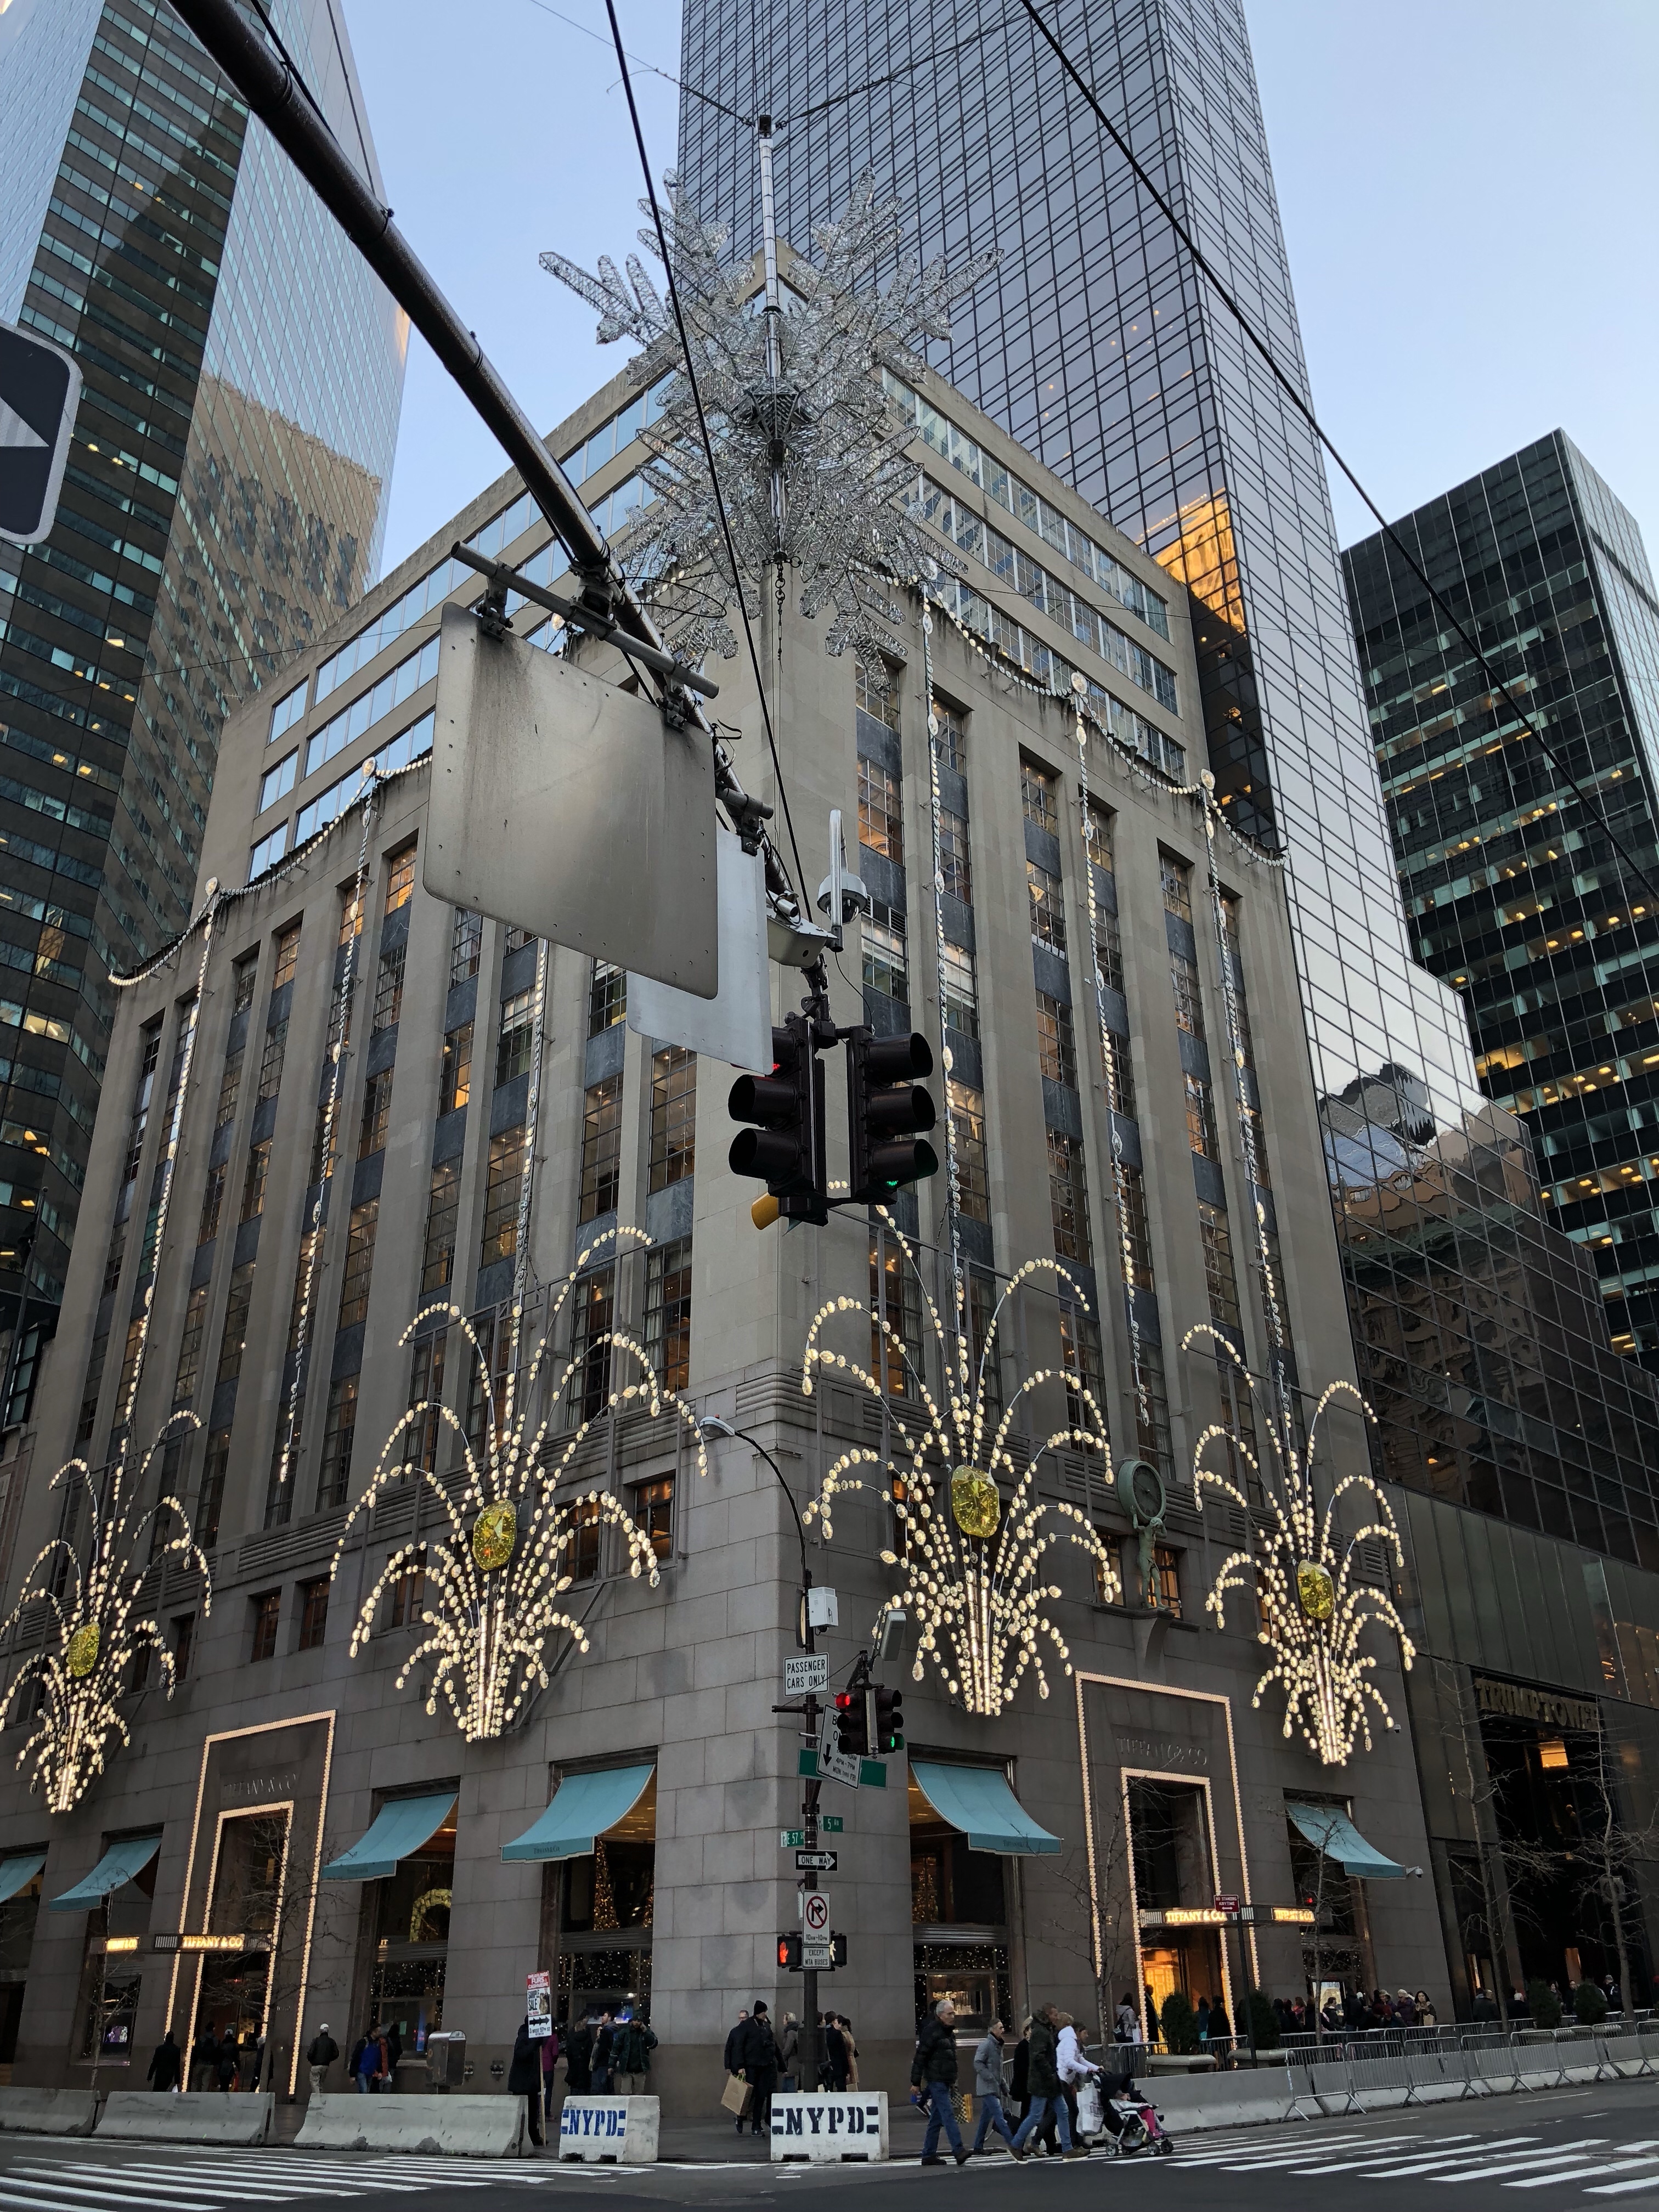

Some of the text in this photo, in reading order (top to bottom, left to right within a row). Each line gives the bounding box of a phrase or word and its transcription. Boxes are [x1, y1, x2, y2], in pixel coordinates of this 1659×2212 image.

[787, 1659, 825, 1674] PASSENGER
[787, 1674, 825, 1689] CARS ONLY
[827, 1819, 831, 1830] 5
[787, 1833, 790, 1844] E
[792, 1832, 798, 1844] 57
[819, 1857, 831, 1865] WAY
[1165, 1910, 1202, 1922] TIFFANY
[1203, 1910, 1210, 1921] &
[183, 1936, 220, 1948] TIFFANY
[221, 1937, 228, 1948] &
[528, 1999, 537, 2011] SALE
[568, 2109, 617, 2136] NYPD
[786, 2107, 864, 2135] NYPD
